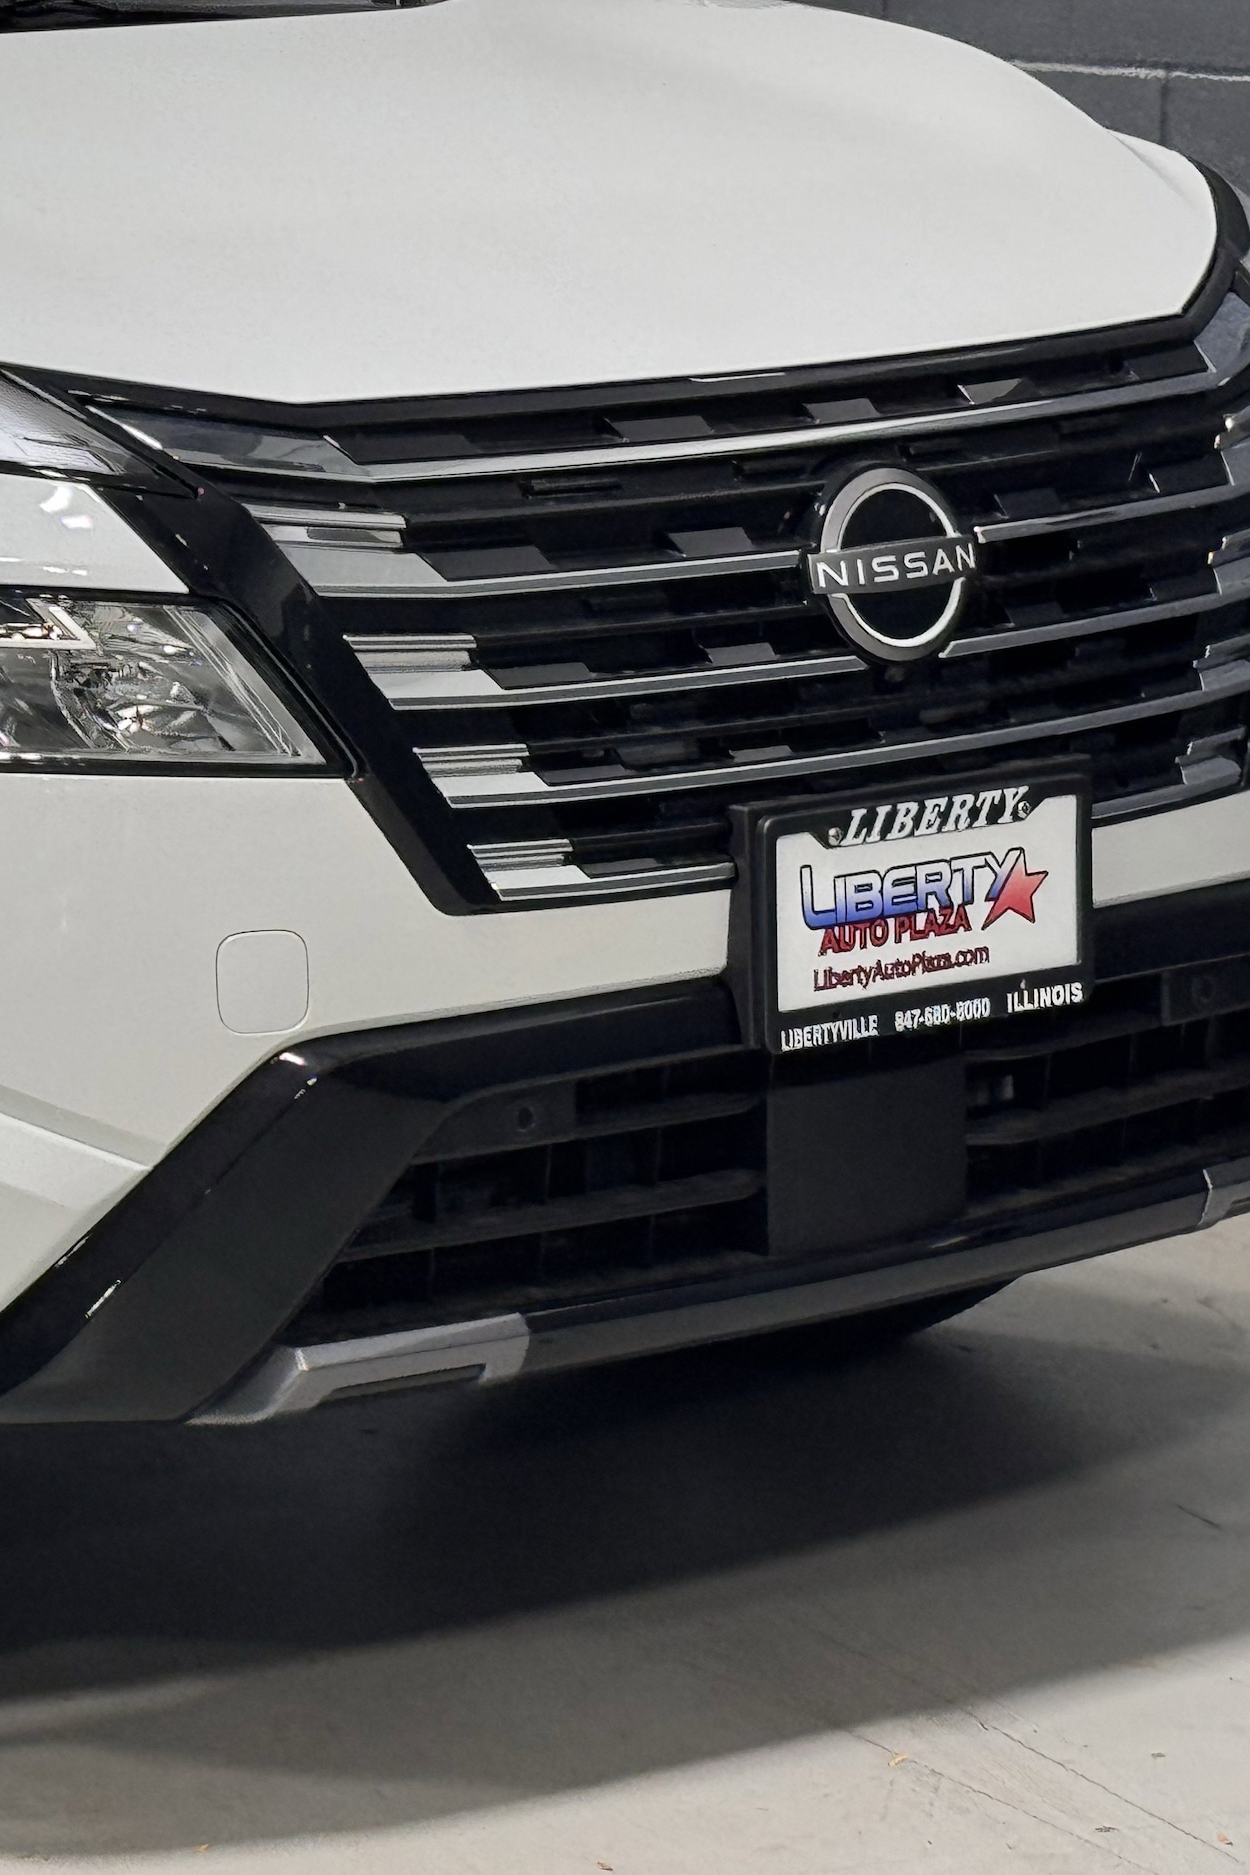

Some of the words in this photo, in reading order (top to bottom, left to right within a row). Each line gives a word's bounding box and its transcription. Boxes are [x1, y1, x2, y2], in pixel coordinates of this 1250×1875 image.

[816, 542, 976, 588] NISSAN
[839, 785, 1030, 847] LIBERTY
[799, 847, 1027, 930] LIBERTY
[817, 918, 890, 957] AUTO
[893, 904, 972, 943] PLAZA
[780, 1014, 880, 1053] LIBERTYVILLE
[1006, 981, 1084, 1014] ILLINOIS
